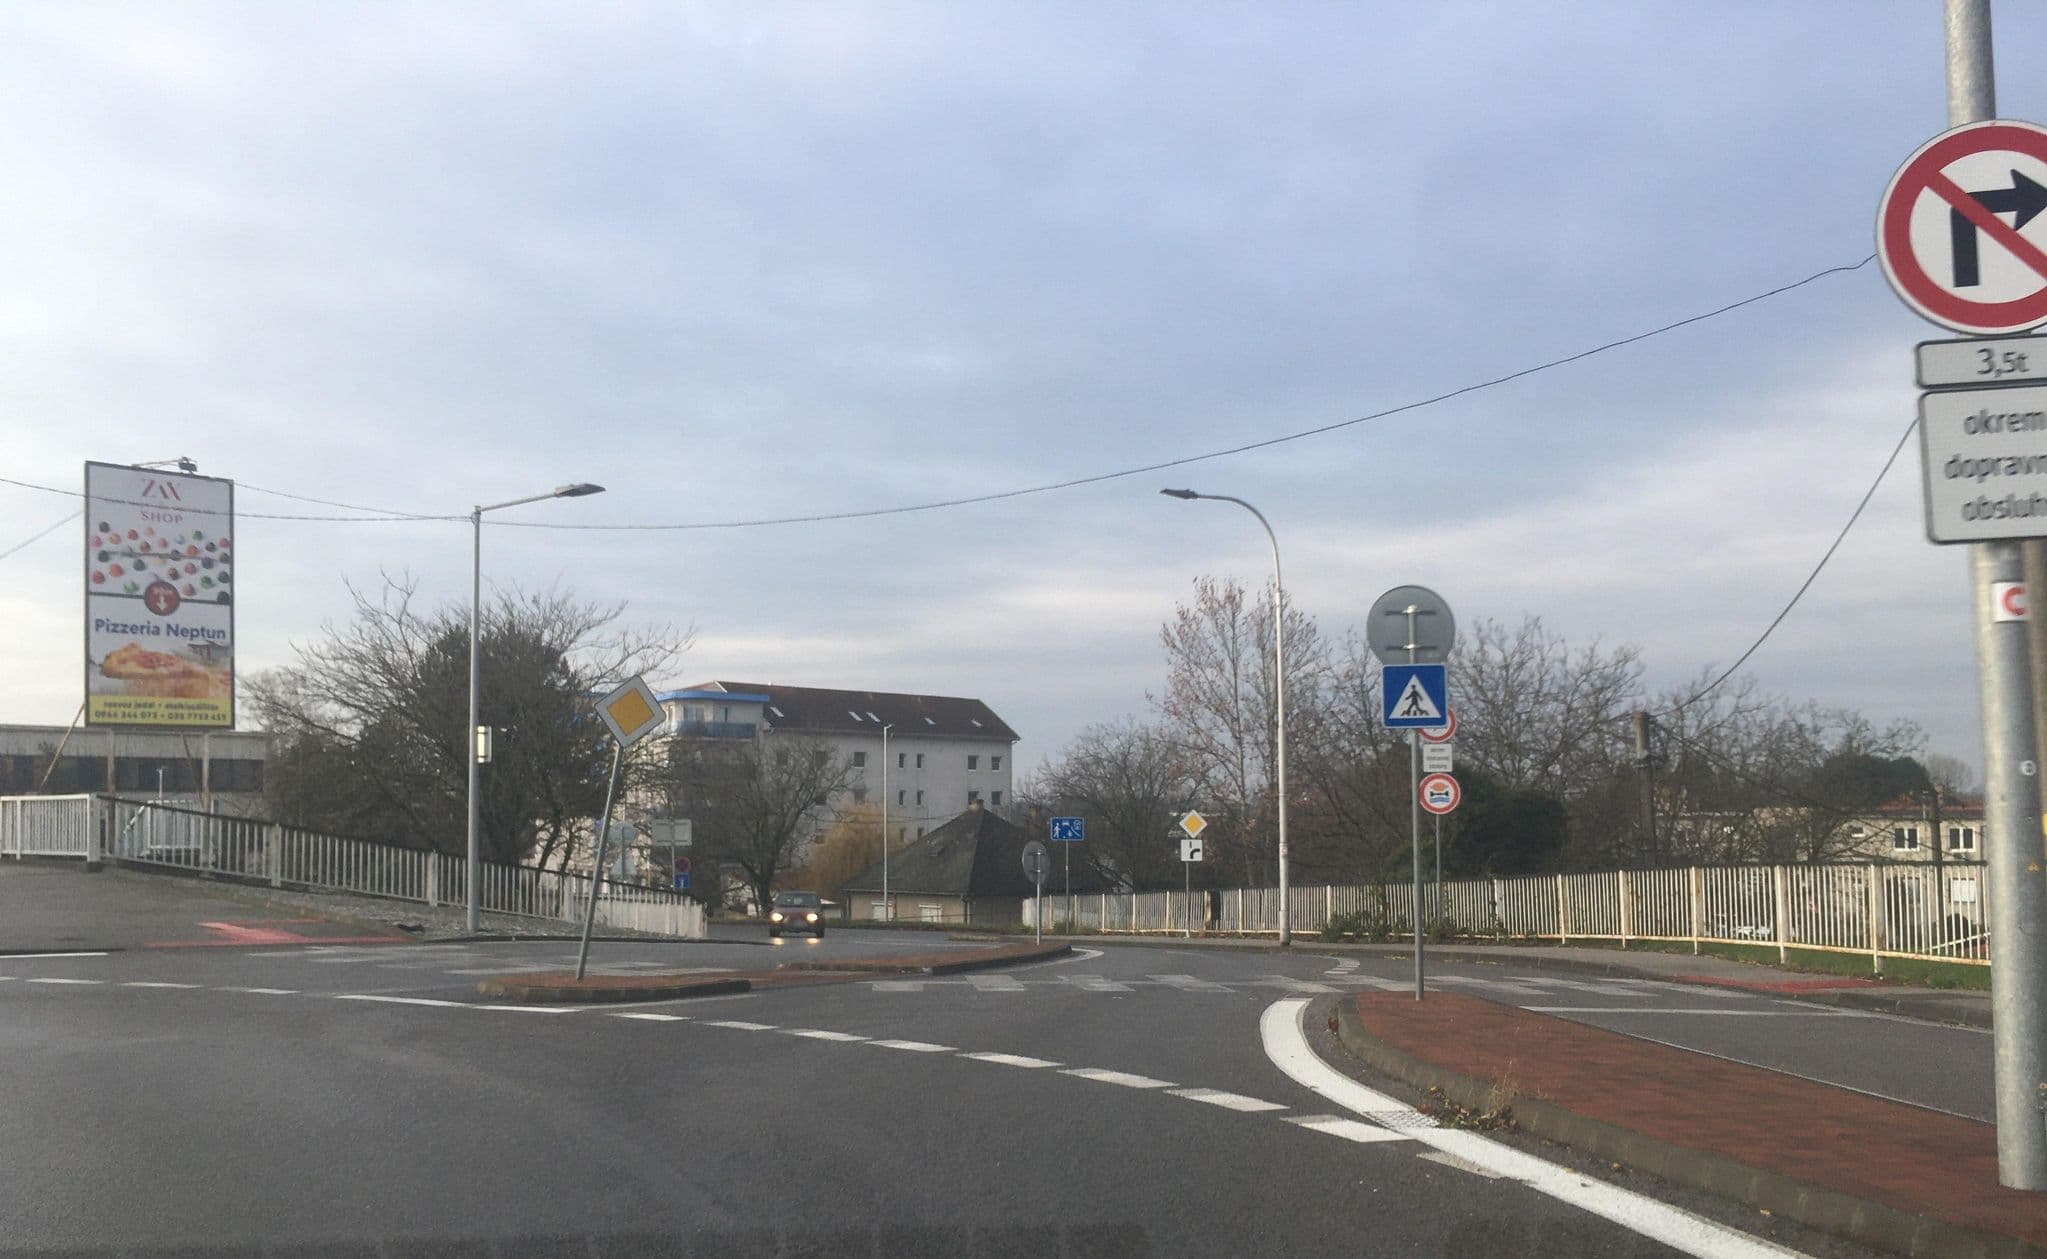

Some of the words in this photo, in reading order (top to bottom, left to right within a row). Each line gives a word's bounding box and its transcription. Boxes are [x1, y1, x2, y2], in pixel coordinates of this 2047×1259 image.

[1976, 347, 2031, 378] 3,5t
[141, 511, 184, 525] SHOP
[94, 618, 160, 636] Pizzeria
[166, 623, 227, 641] Neptun
